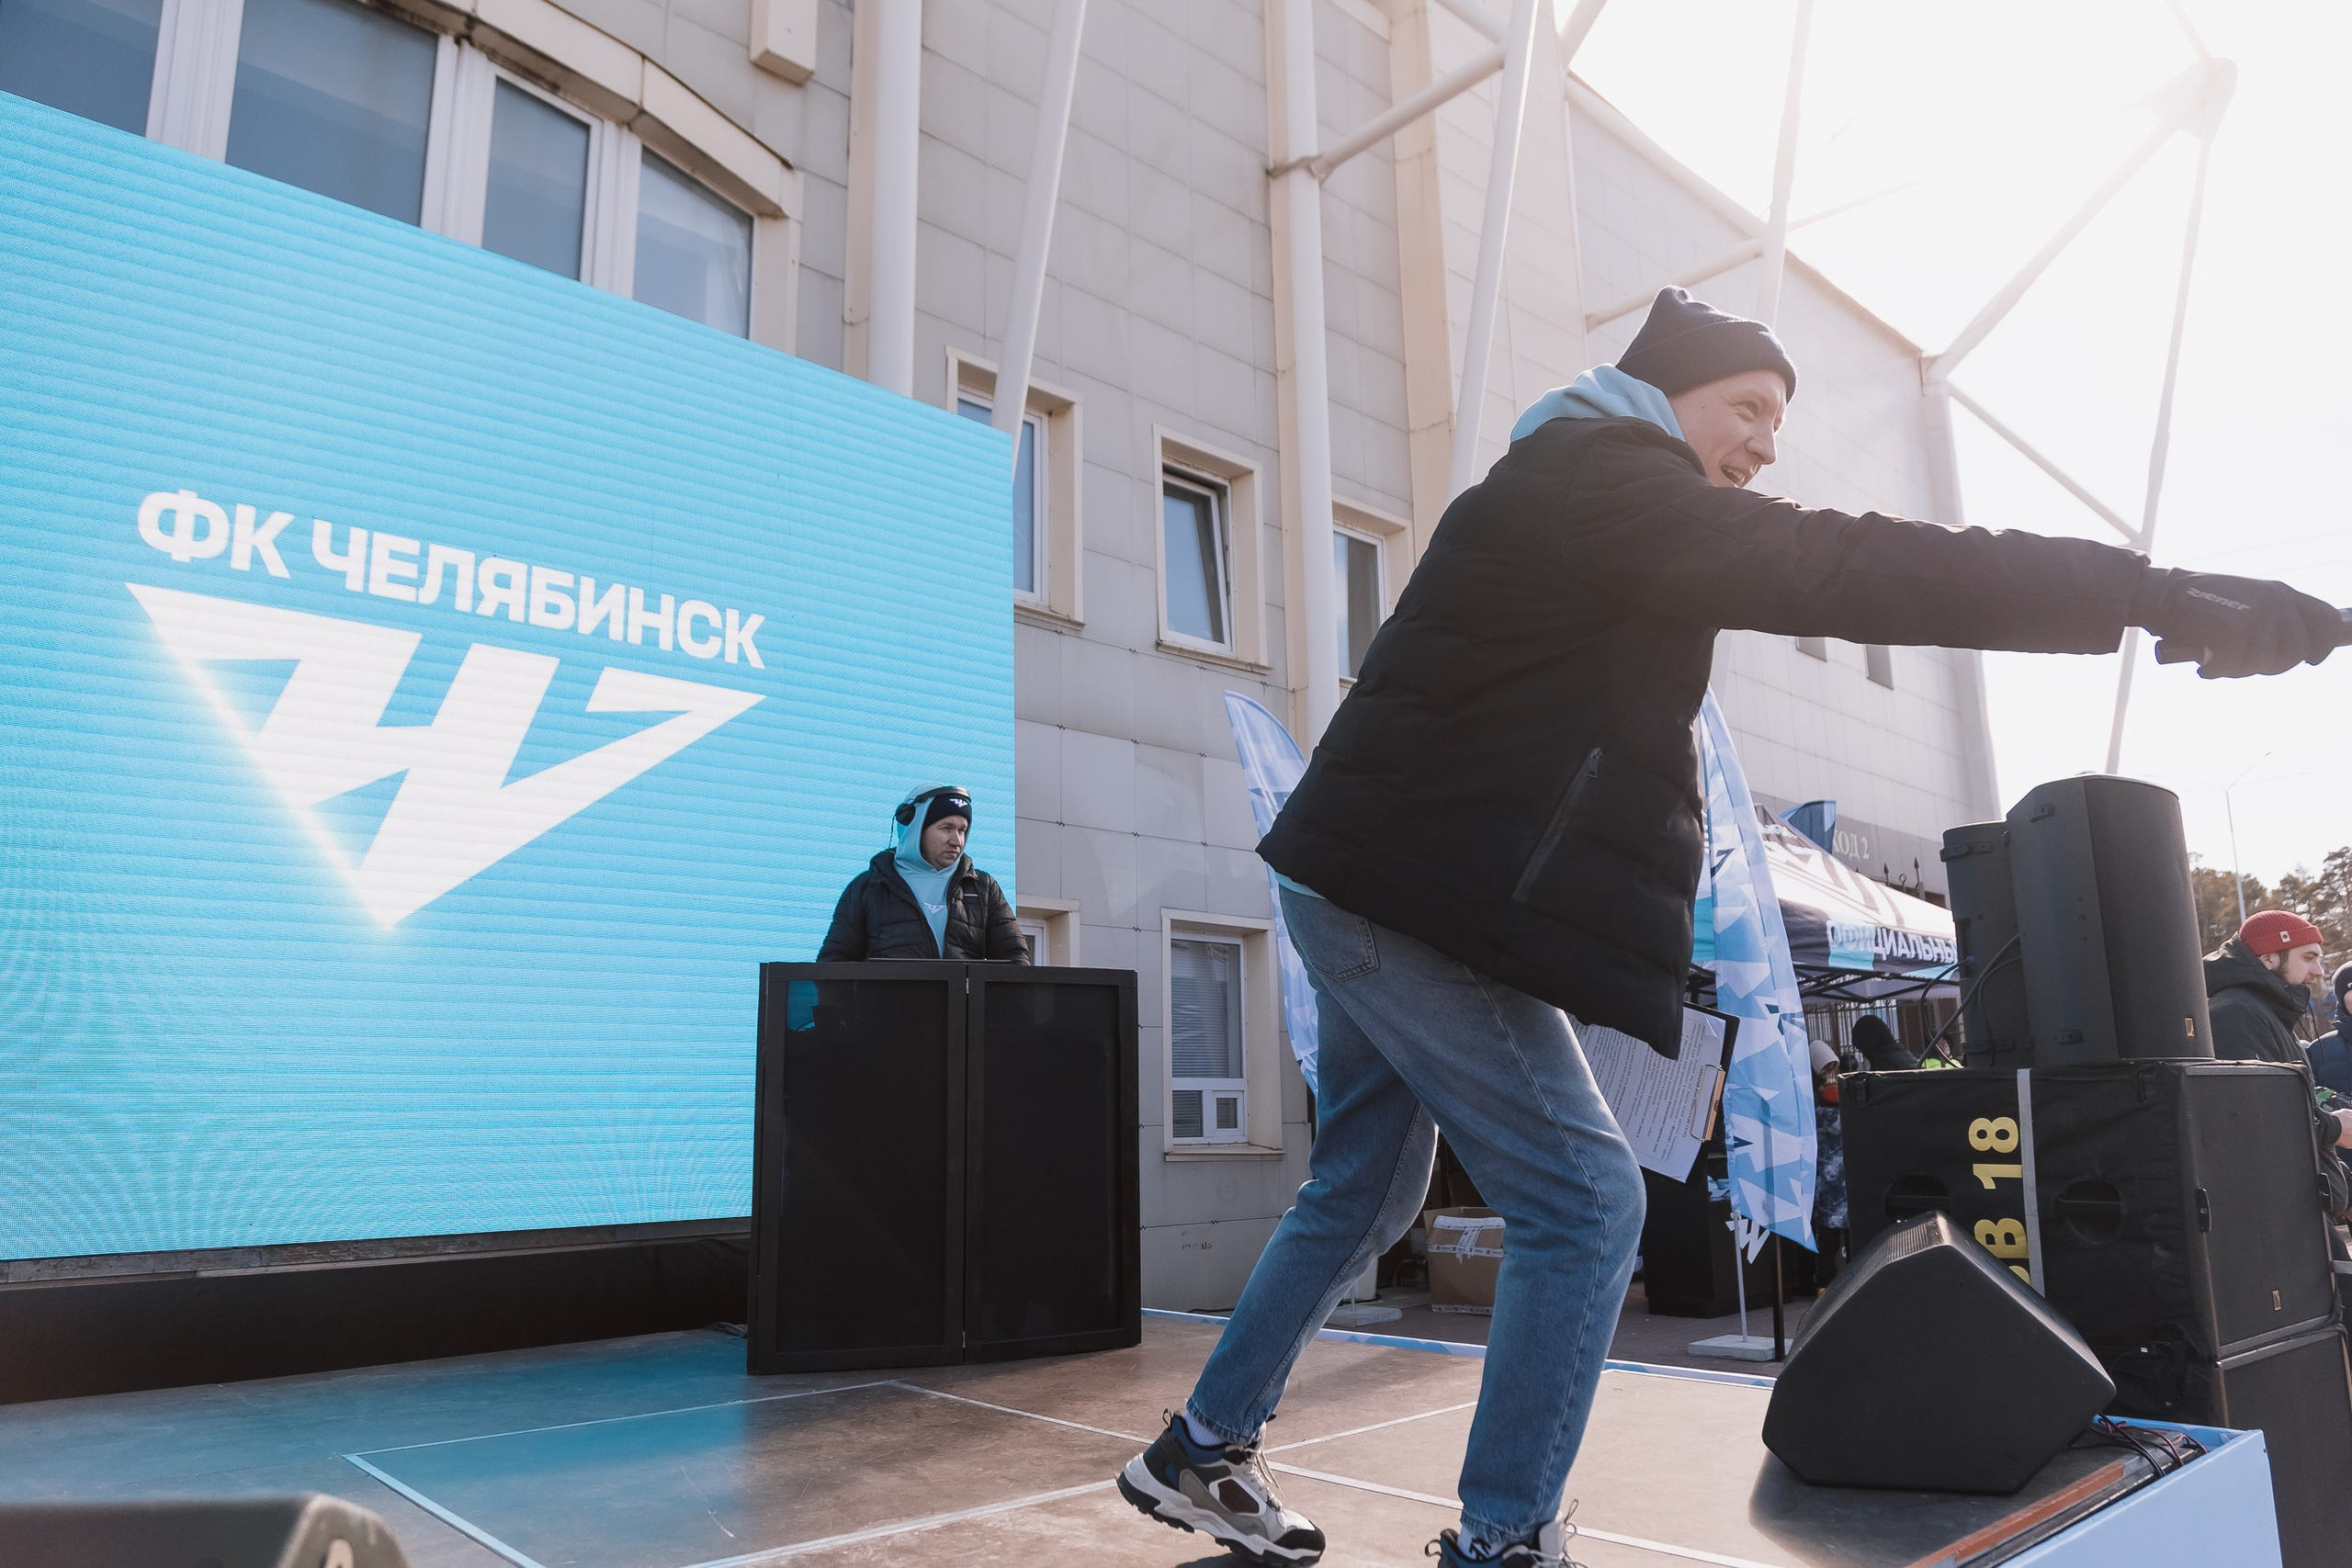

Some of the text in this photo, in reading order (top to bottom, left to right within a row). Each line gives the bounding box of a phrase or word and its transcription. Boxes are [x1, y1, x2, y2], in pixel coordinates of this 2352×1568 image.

[136, 488, 766, 670] ФК ЧЕЛЯБИНСК
[1861, 836, 1871, 860] 2
[1826, 919, 1959, 964] ОФИЦИАЛЬНЫ
[1968, 1116, 2023, 1190] 18
